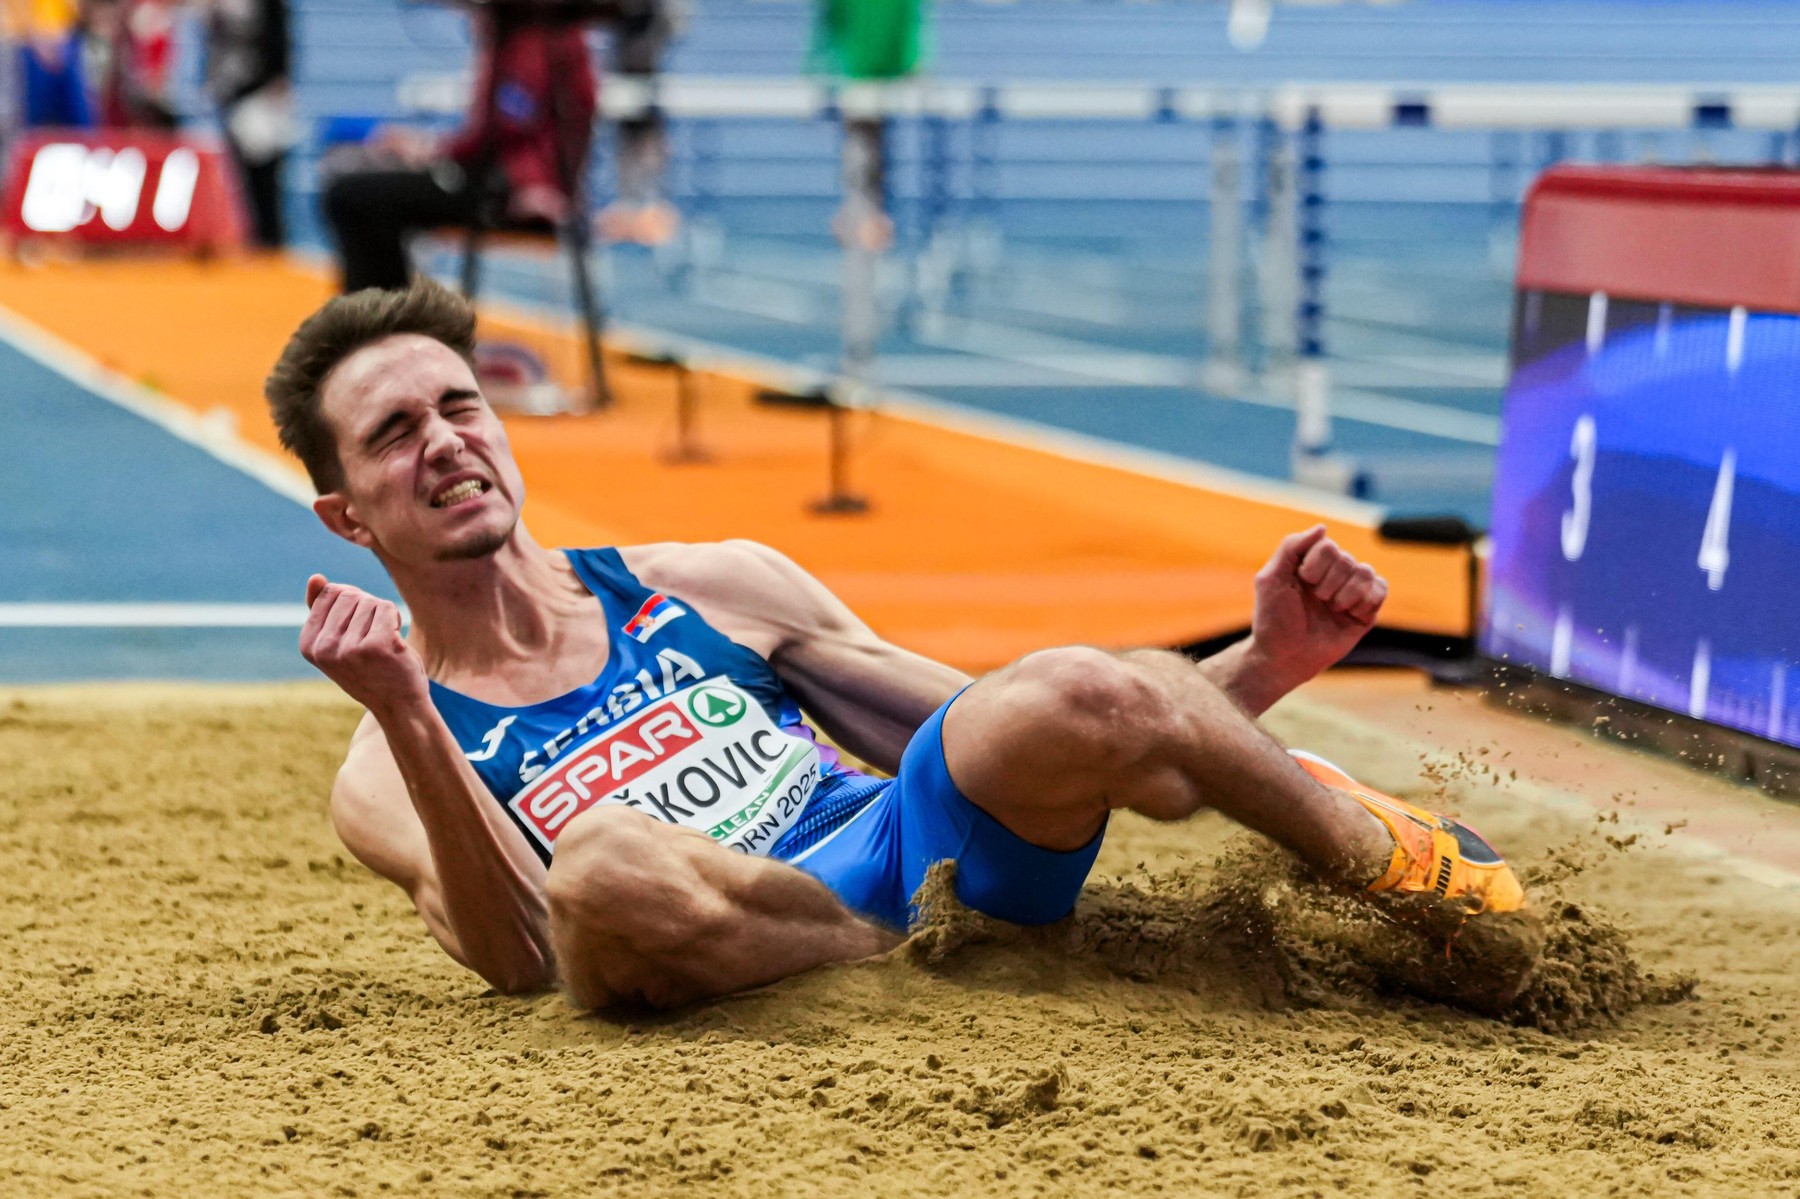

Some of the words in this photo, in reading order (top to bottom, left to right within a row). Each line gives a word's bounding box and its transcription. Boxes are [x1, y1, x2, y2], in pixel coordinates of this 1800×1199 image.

[1561, 413, 1597, 563] 3
[1697, 446, 1738, 592] 4
[529, 710, 693, 831] SPAR
[776, 763, 816, 819] 2025
